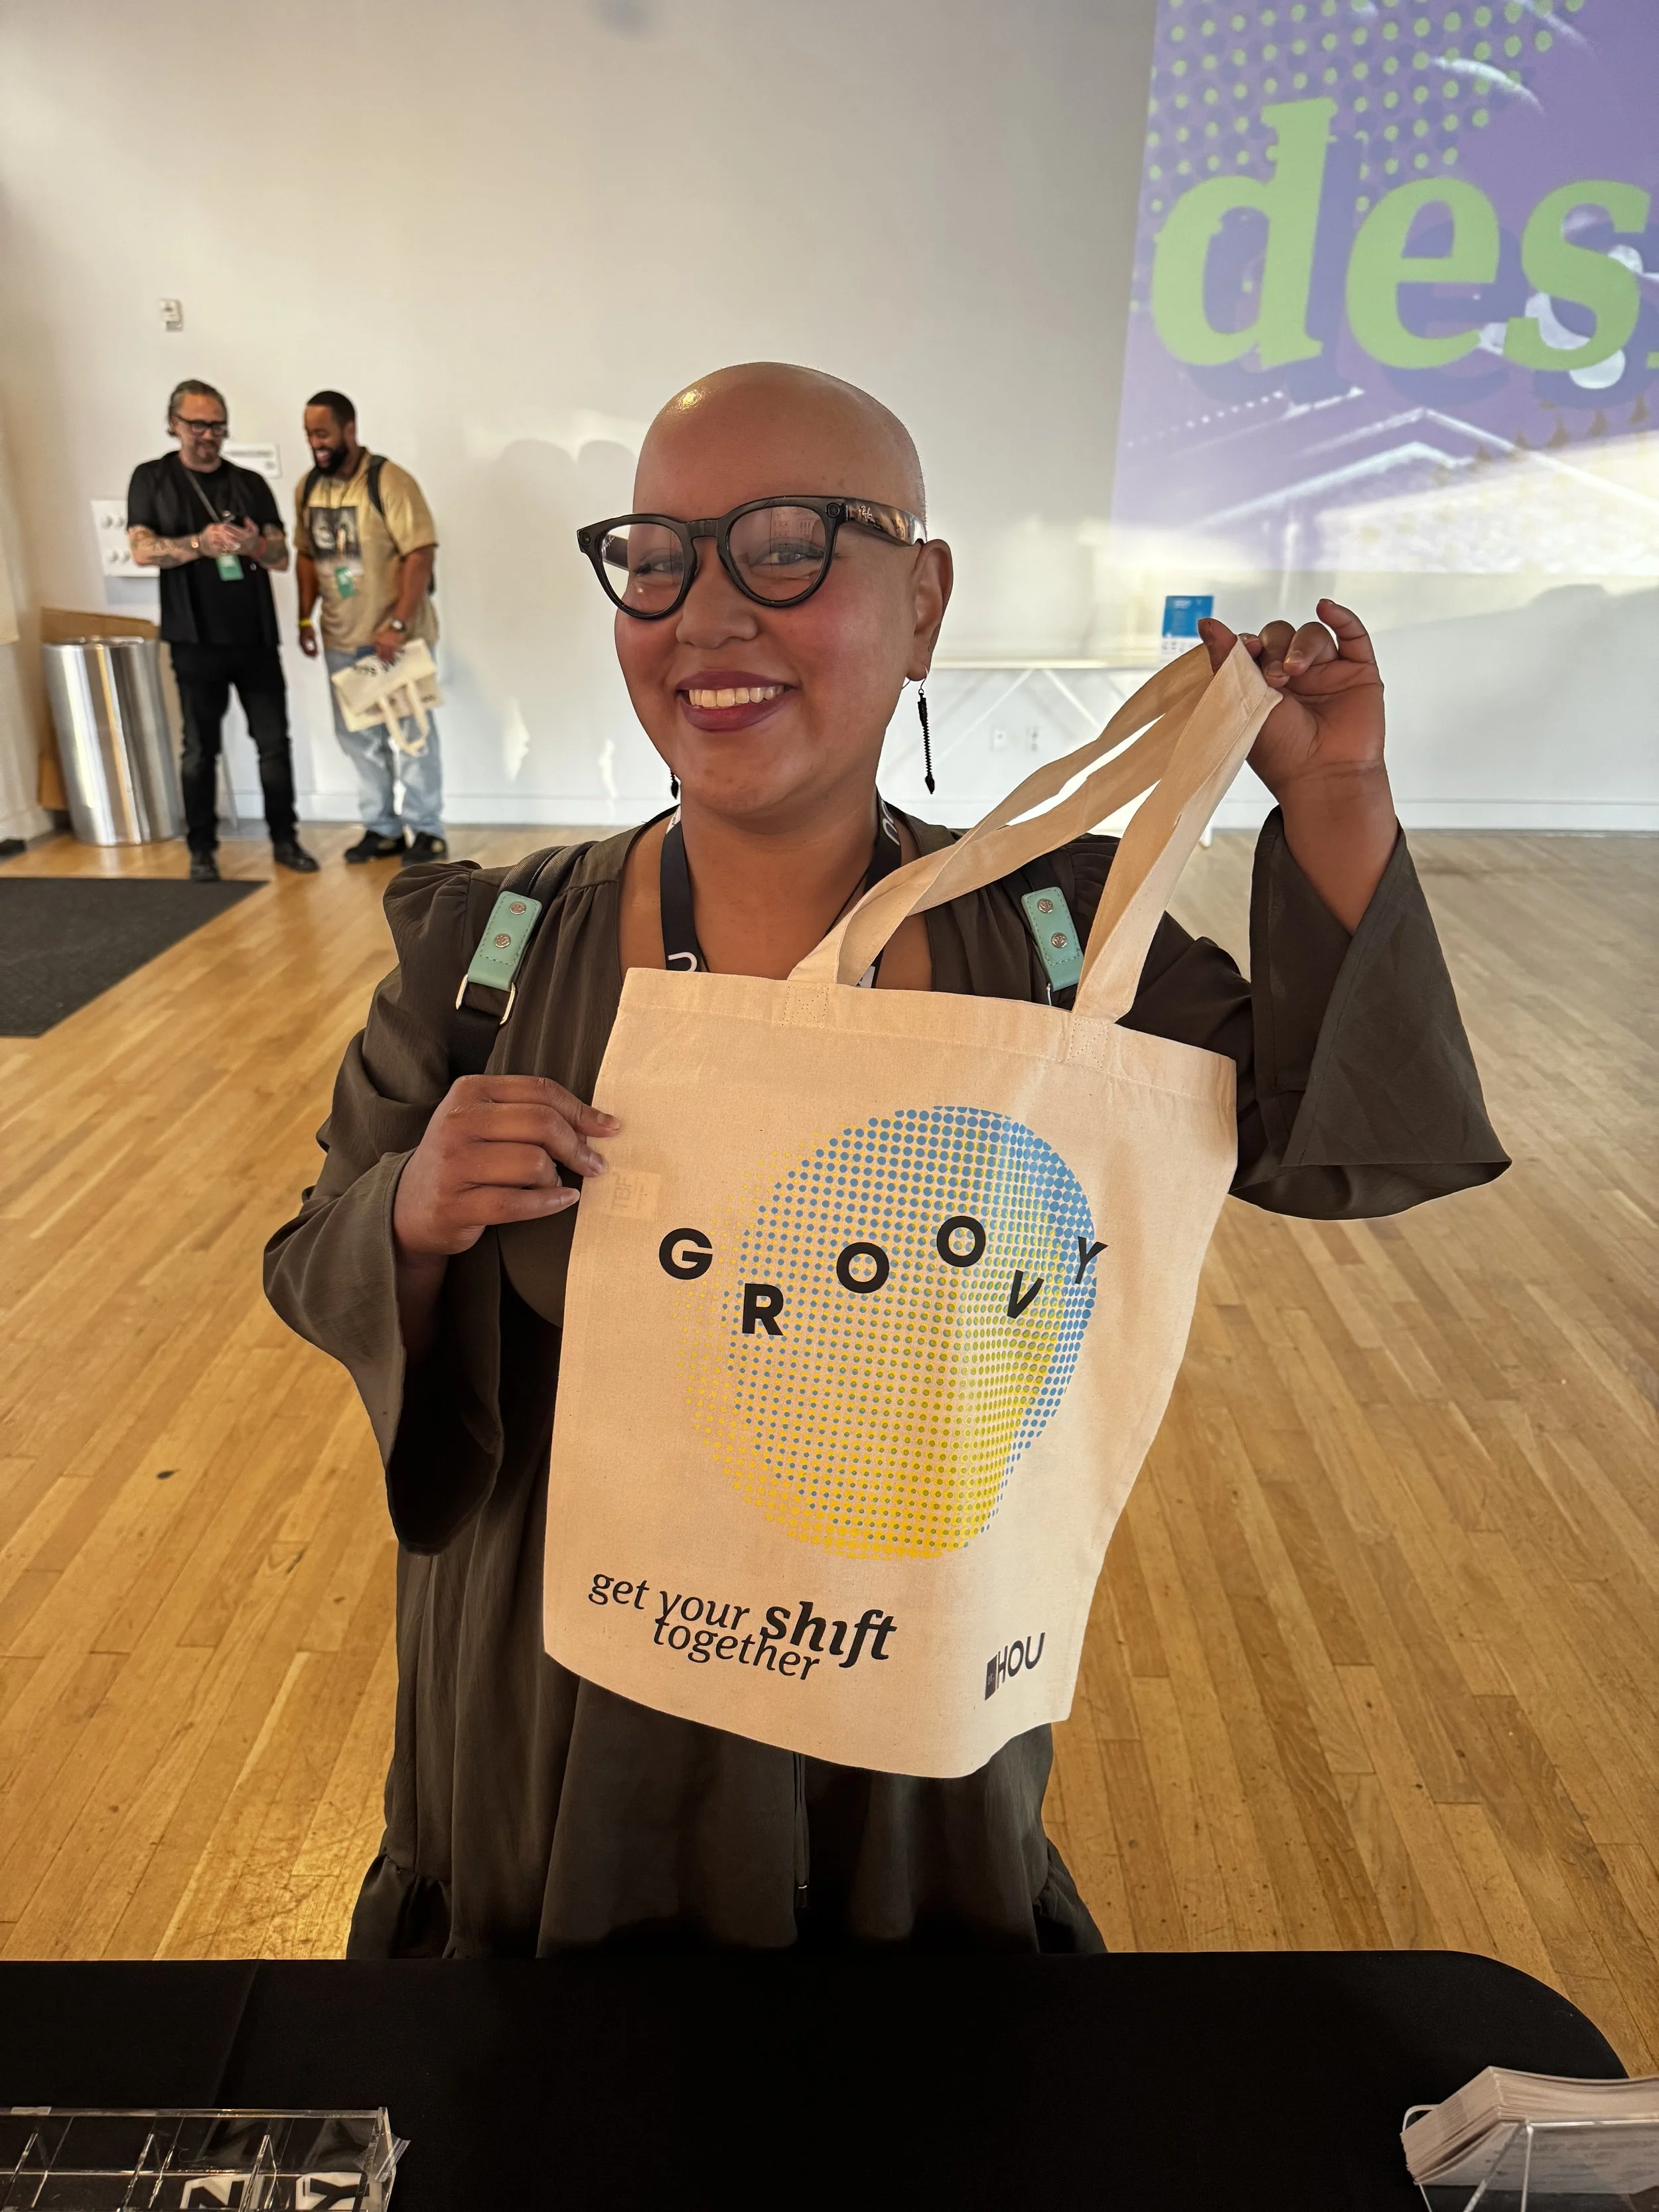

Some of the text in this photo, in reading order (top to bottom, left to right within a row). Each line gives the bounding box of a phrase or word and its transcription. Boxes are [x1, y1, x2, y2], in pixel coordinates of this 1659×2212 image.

[1150, 96, 1659, 372] des
[658, 1215, 1109, 1337] GROOVY
[588, 1574, 650, 1610] get
[659, 1590, 751, 1630] your
[653, 1613, 820, 1680] together
[997, 1632, 1046, 1690] HOU
